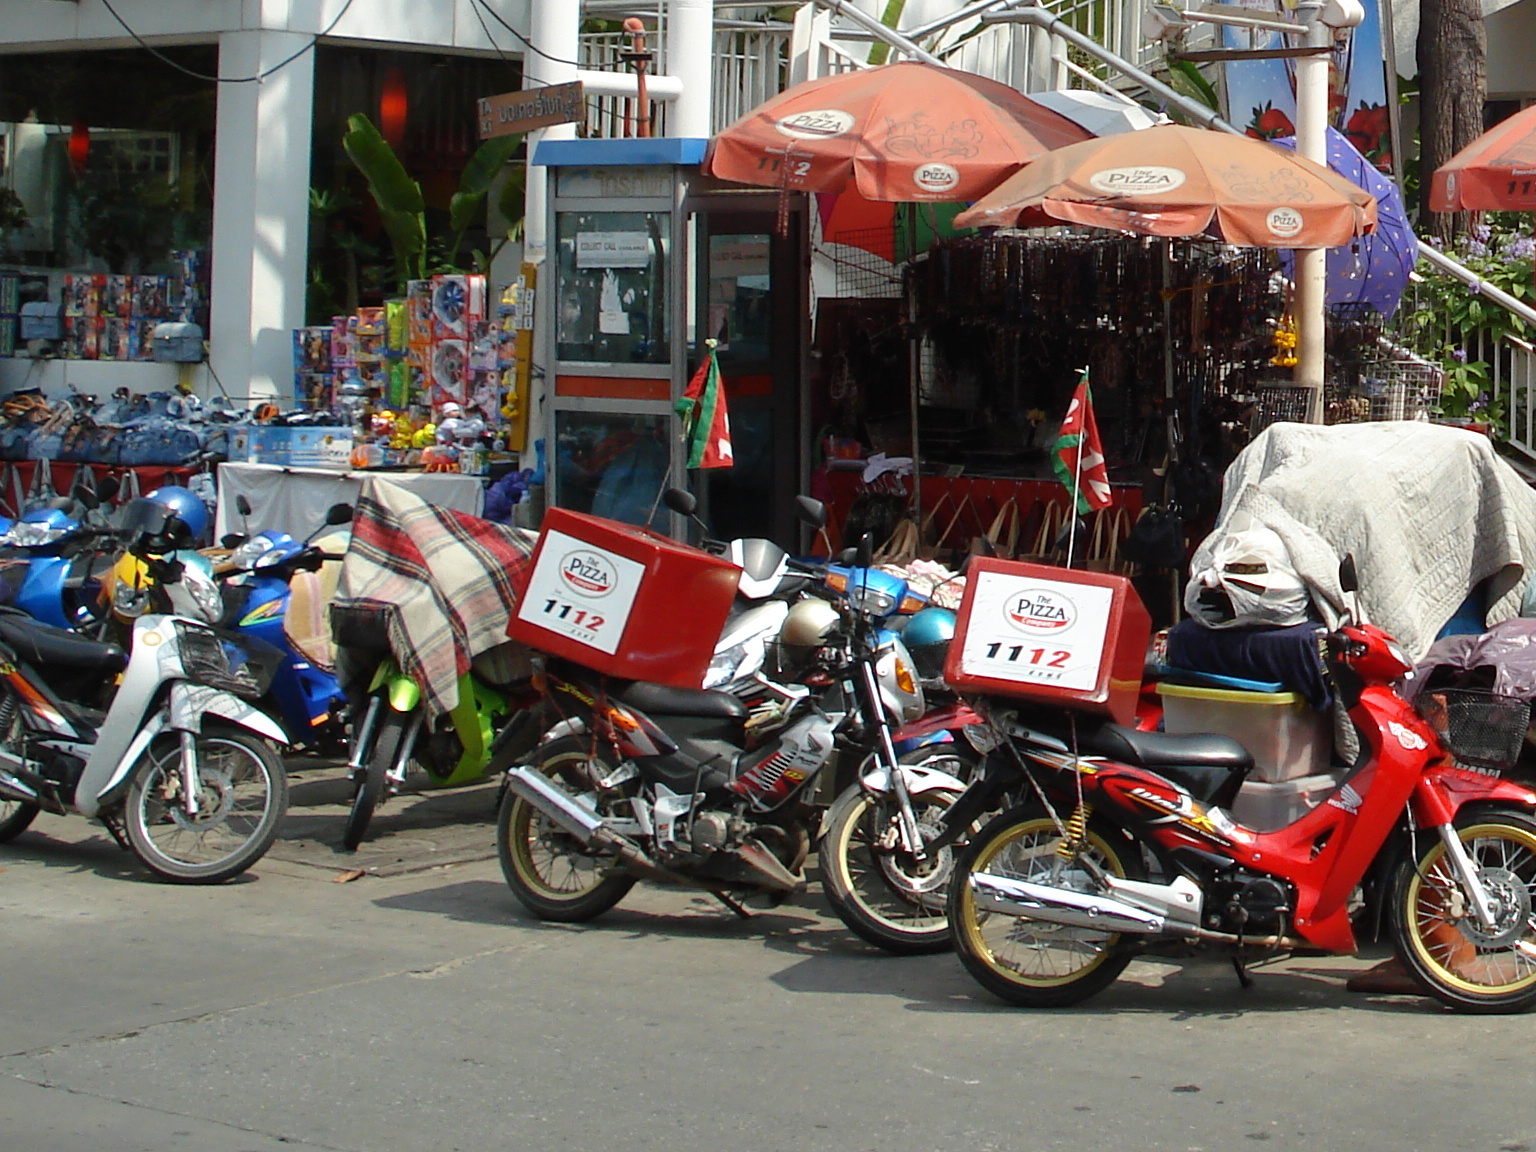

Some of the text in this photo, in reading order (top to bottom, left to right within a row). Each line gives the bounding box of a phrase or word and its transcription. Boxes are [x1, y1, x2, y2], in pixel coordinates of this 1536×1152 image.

[791, 114, 841, 132] PIZZA
[922, 170, 951, 180] PIZZA
[1108, 173, 1171, 184] PIZZA
[1273, 215, 1298, 225] PIZZA
[569, 557, 608, 585] PIZZA
[1036, 595, 1052, 604] The
[543, 598, 605, 633] 1112
[1017, 598, 1066, 620] PIZZA
[985, 642, 1072, 668] 1112
[1327, 797, 1359, 815] HONDA
